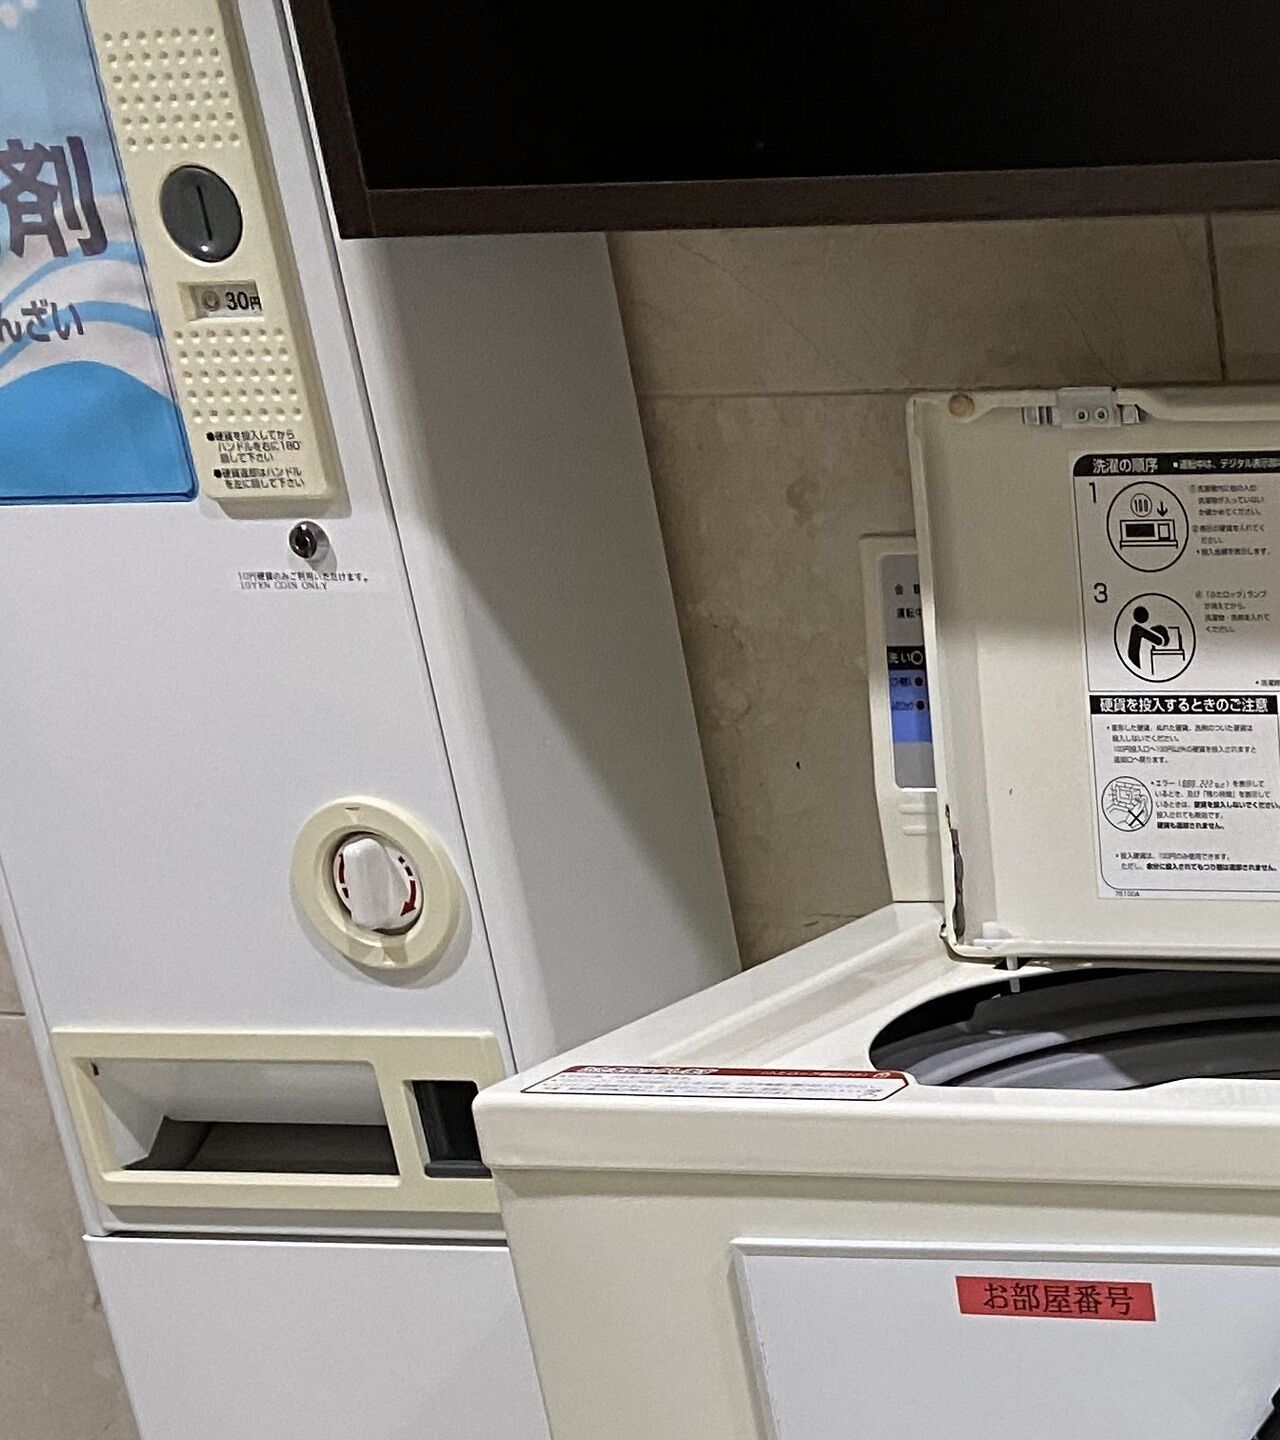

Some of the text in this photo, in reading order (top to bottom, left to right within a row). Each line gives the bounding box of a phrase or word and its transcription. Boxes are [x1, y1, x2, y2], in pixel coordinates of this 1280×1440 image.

[0, 136, 108, 257] 剤
[1093, 457, 1158, 474] 洗濯の順序
[1088, 481, 1097, 504] 1
[1093, 582, 1108, 604] 3
[1100, 697, 1269, 713] 硬貨を投入するときのご注意
[983, 1281, 1135, 1317] お部屋番号
